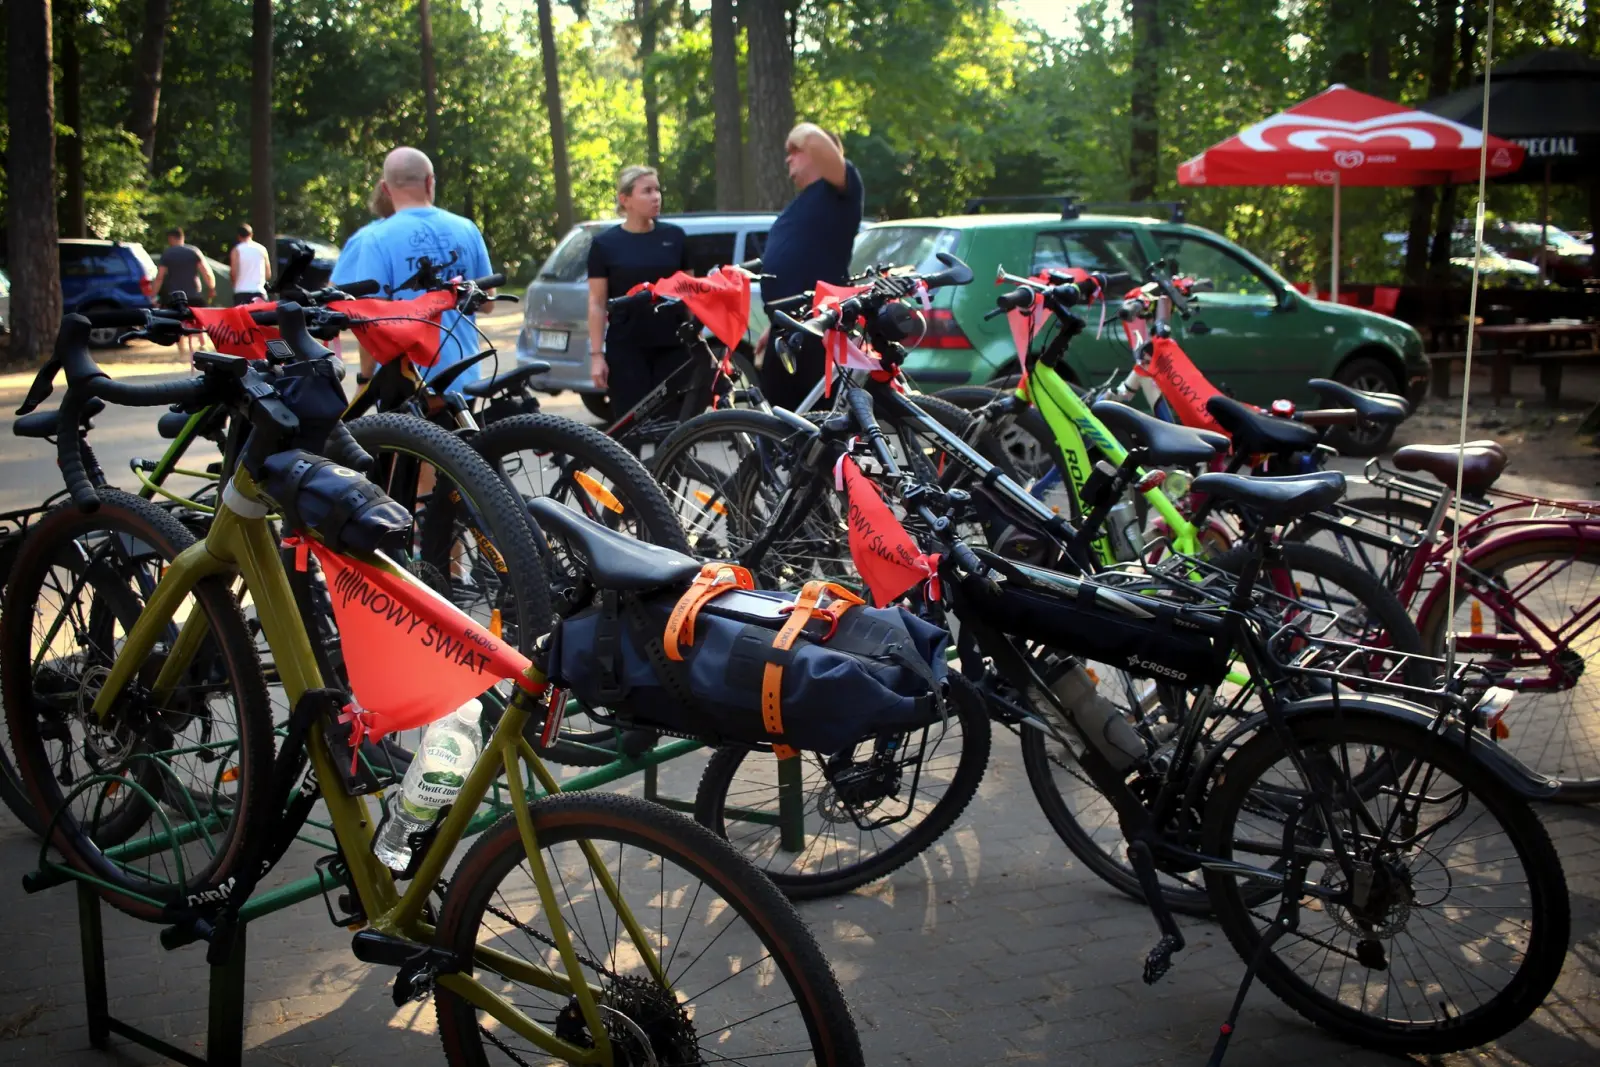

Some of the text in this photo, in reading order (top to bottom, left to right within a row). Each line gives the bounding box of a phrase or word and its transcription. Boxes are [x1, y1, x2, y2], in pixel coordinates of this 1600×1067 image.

[353, 582, 492, 676] NOWY ŚWIAT
[464, 628, 499, 652] RADIO
[1140, 659, 1188, 681] CROSSO
